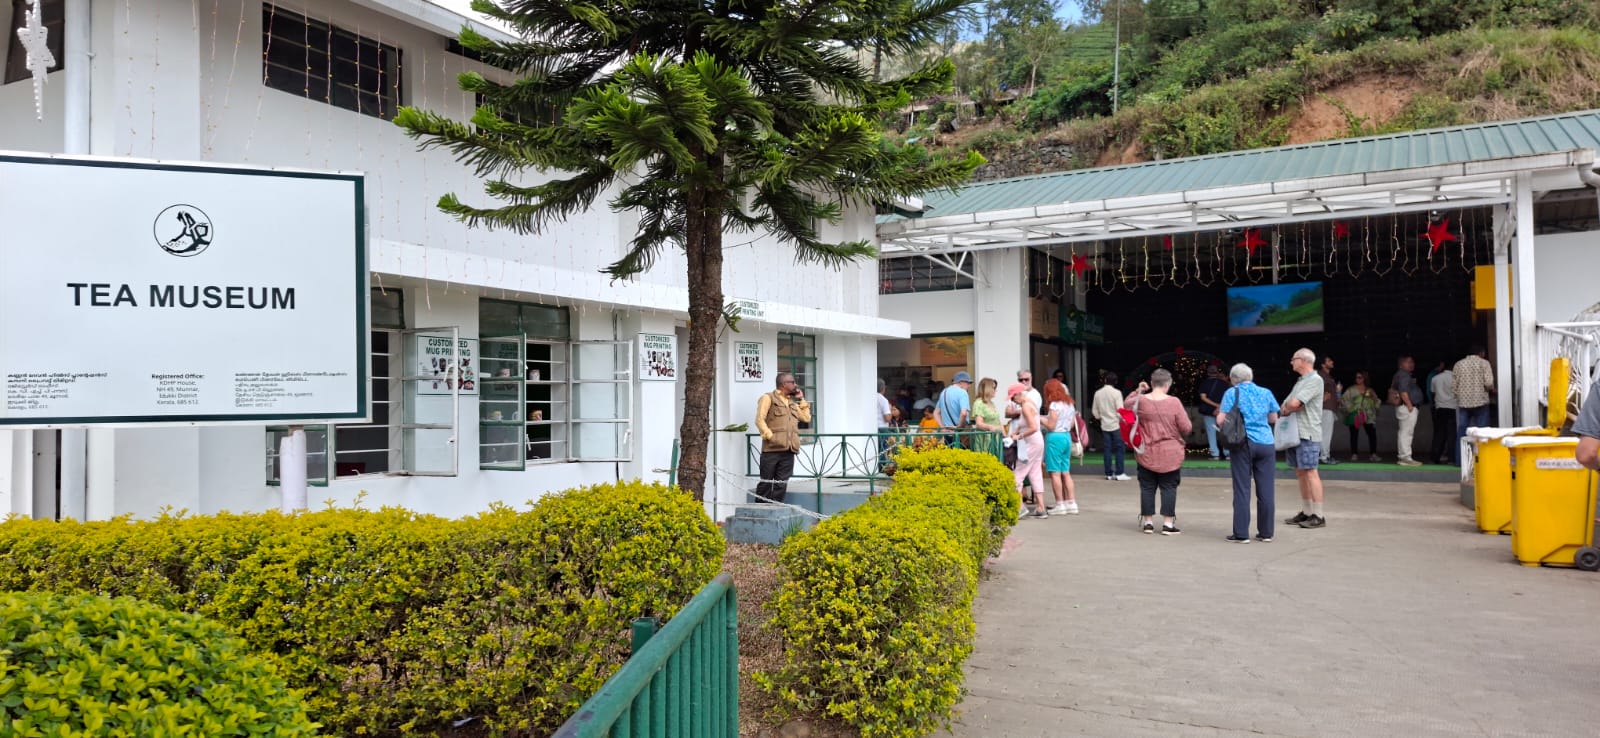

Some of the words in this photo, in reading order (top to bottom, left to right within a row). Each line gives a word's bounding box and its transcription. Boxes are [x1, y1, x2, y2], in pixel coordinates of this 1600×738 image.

[67, 283, 138, 307] TEA
[149, 284, 295, 310] MUSEUM
[428, 338, 468, 348] CUSTOMZED
[645, 335, 670, 343] CUSTOMIZED
[425, 346, 440, 355] MUG
[653, 342, 672, 350] PRINTING
